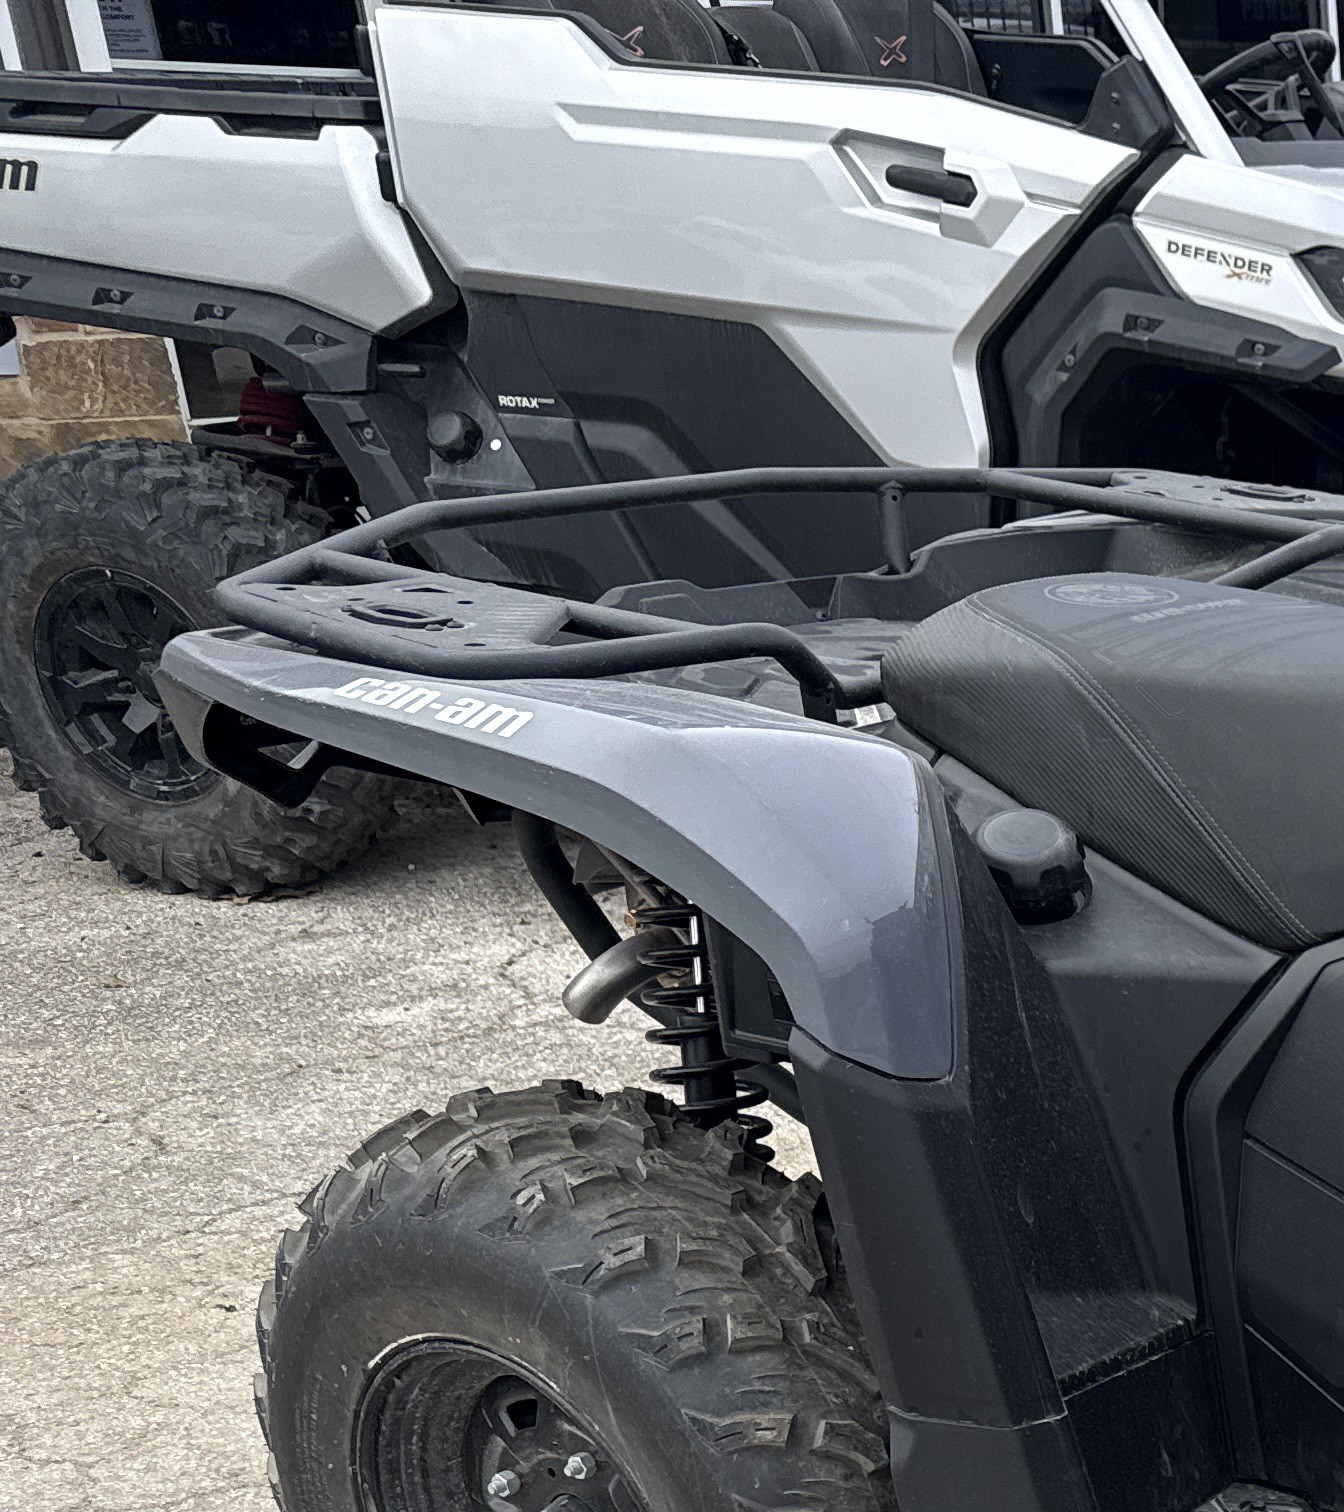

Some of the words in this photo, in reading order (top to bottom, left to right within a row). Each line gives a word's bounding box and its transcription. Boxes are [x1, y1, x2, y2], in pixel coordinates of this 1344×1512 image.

[1167, 240, 1273, 277] DEFENDER
[498, 394, 539, 408] ROTAX
[332, 677, 534, 738] can-am
